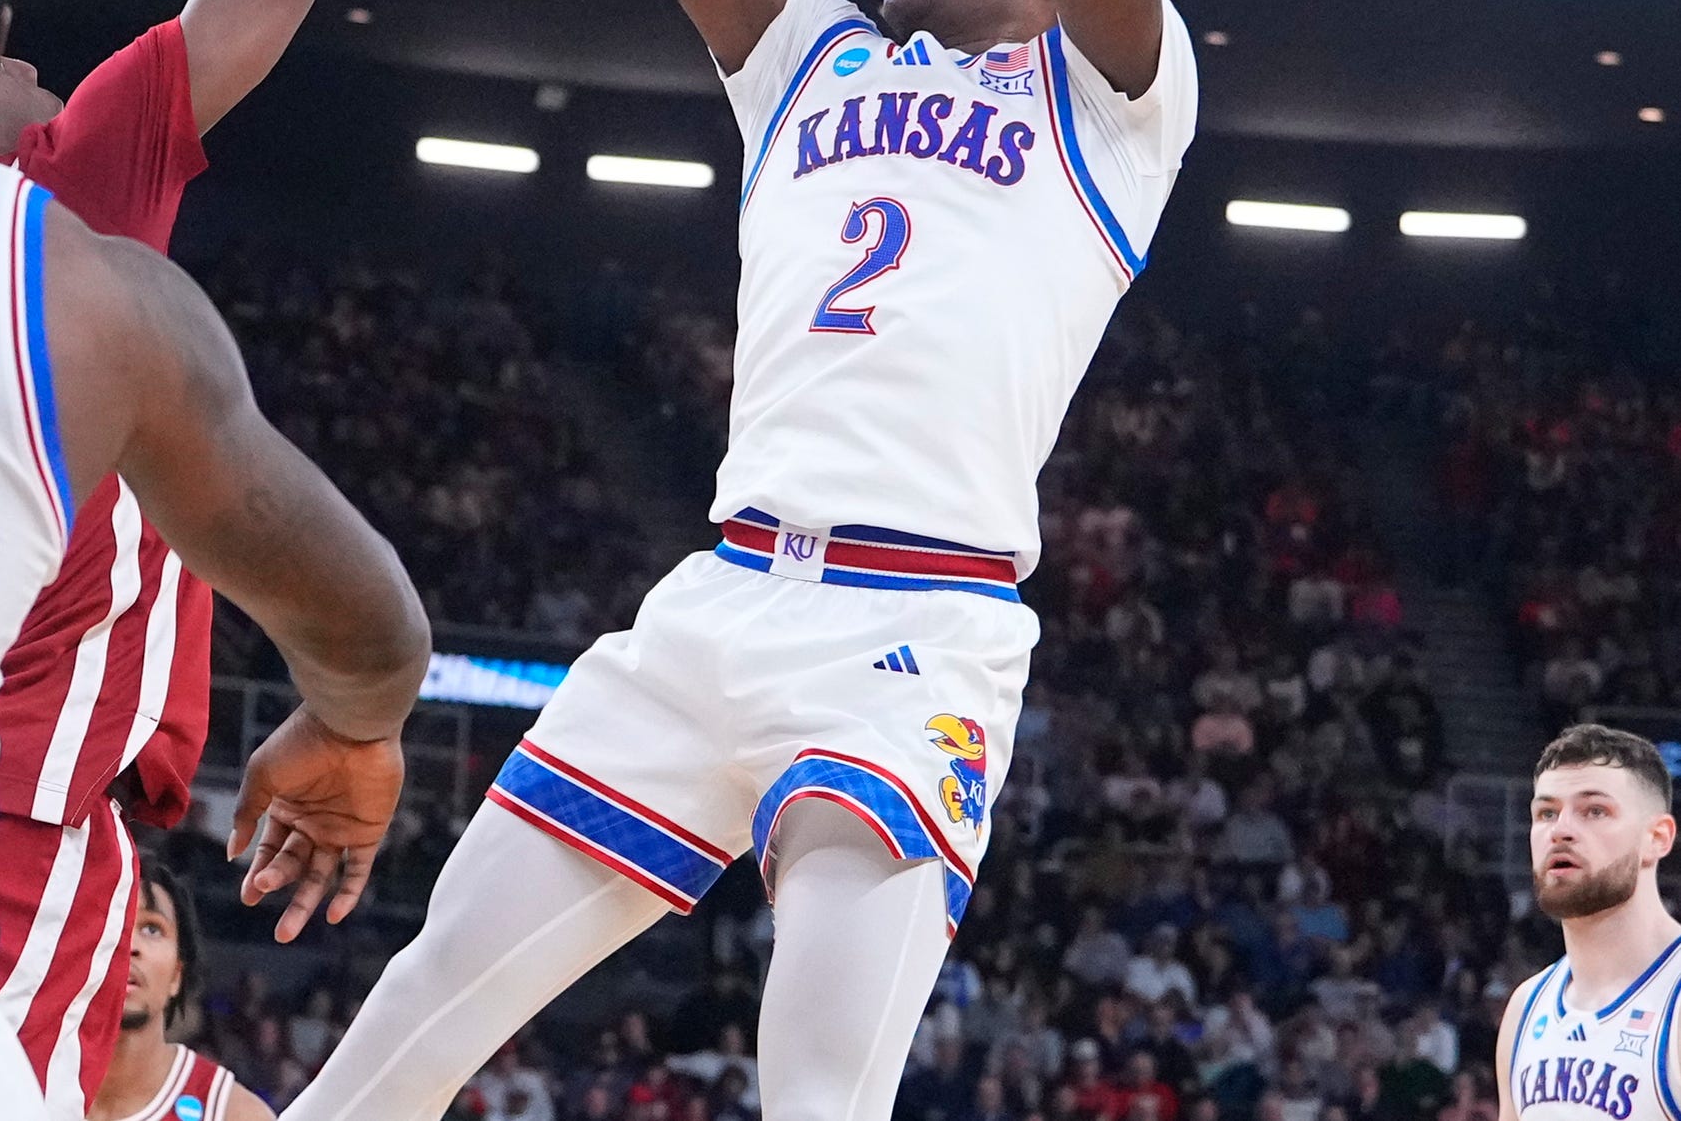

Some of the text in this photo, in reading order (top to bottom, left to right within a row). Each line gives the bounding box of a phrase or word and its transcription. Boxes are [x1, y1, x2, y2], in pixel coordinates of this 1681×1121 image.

[793, 91, 1035, 186] KANSAS
[809, 196, 911, 335] 2
[783, 532, 818, 562] KU
[1520, 1056, 1639, 1120] KANSAS
